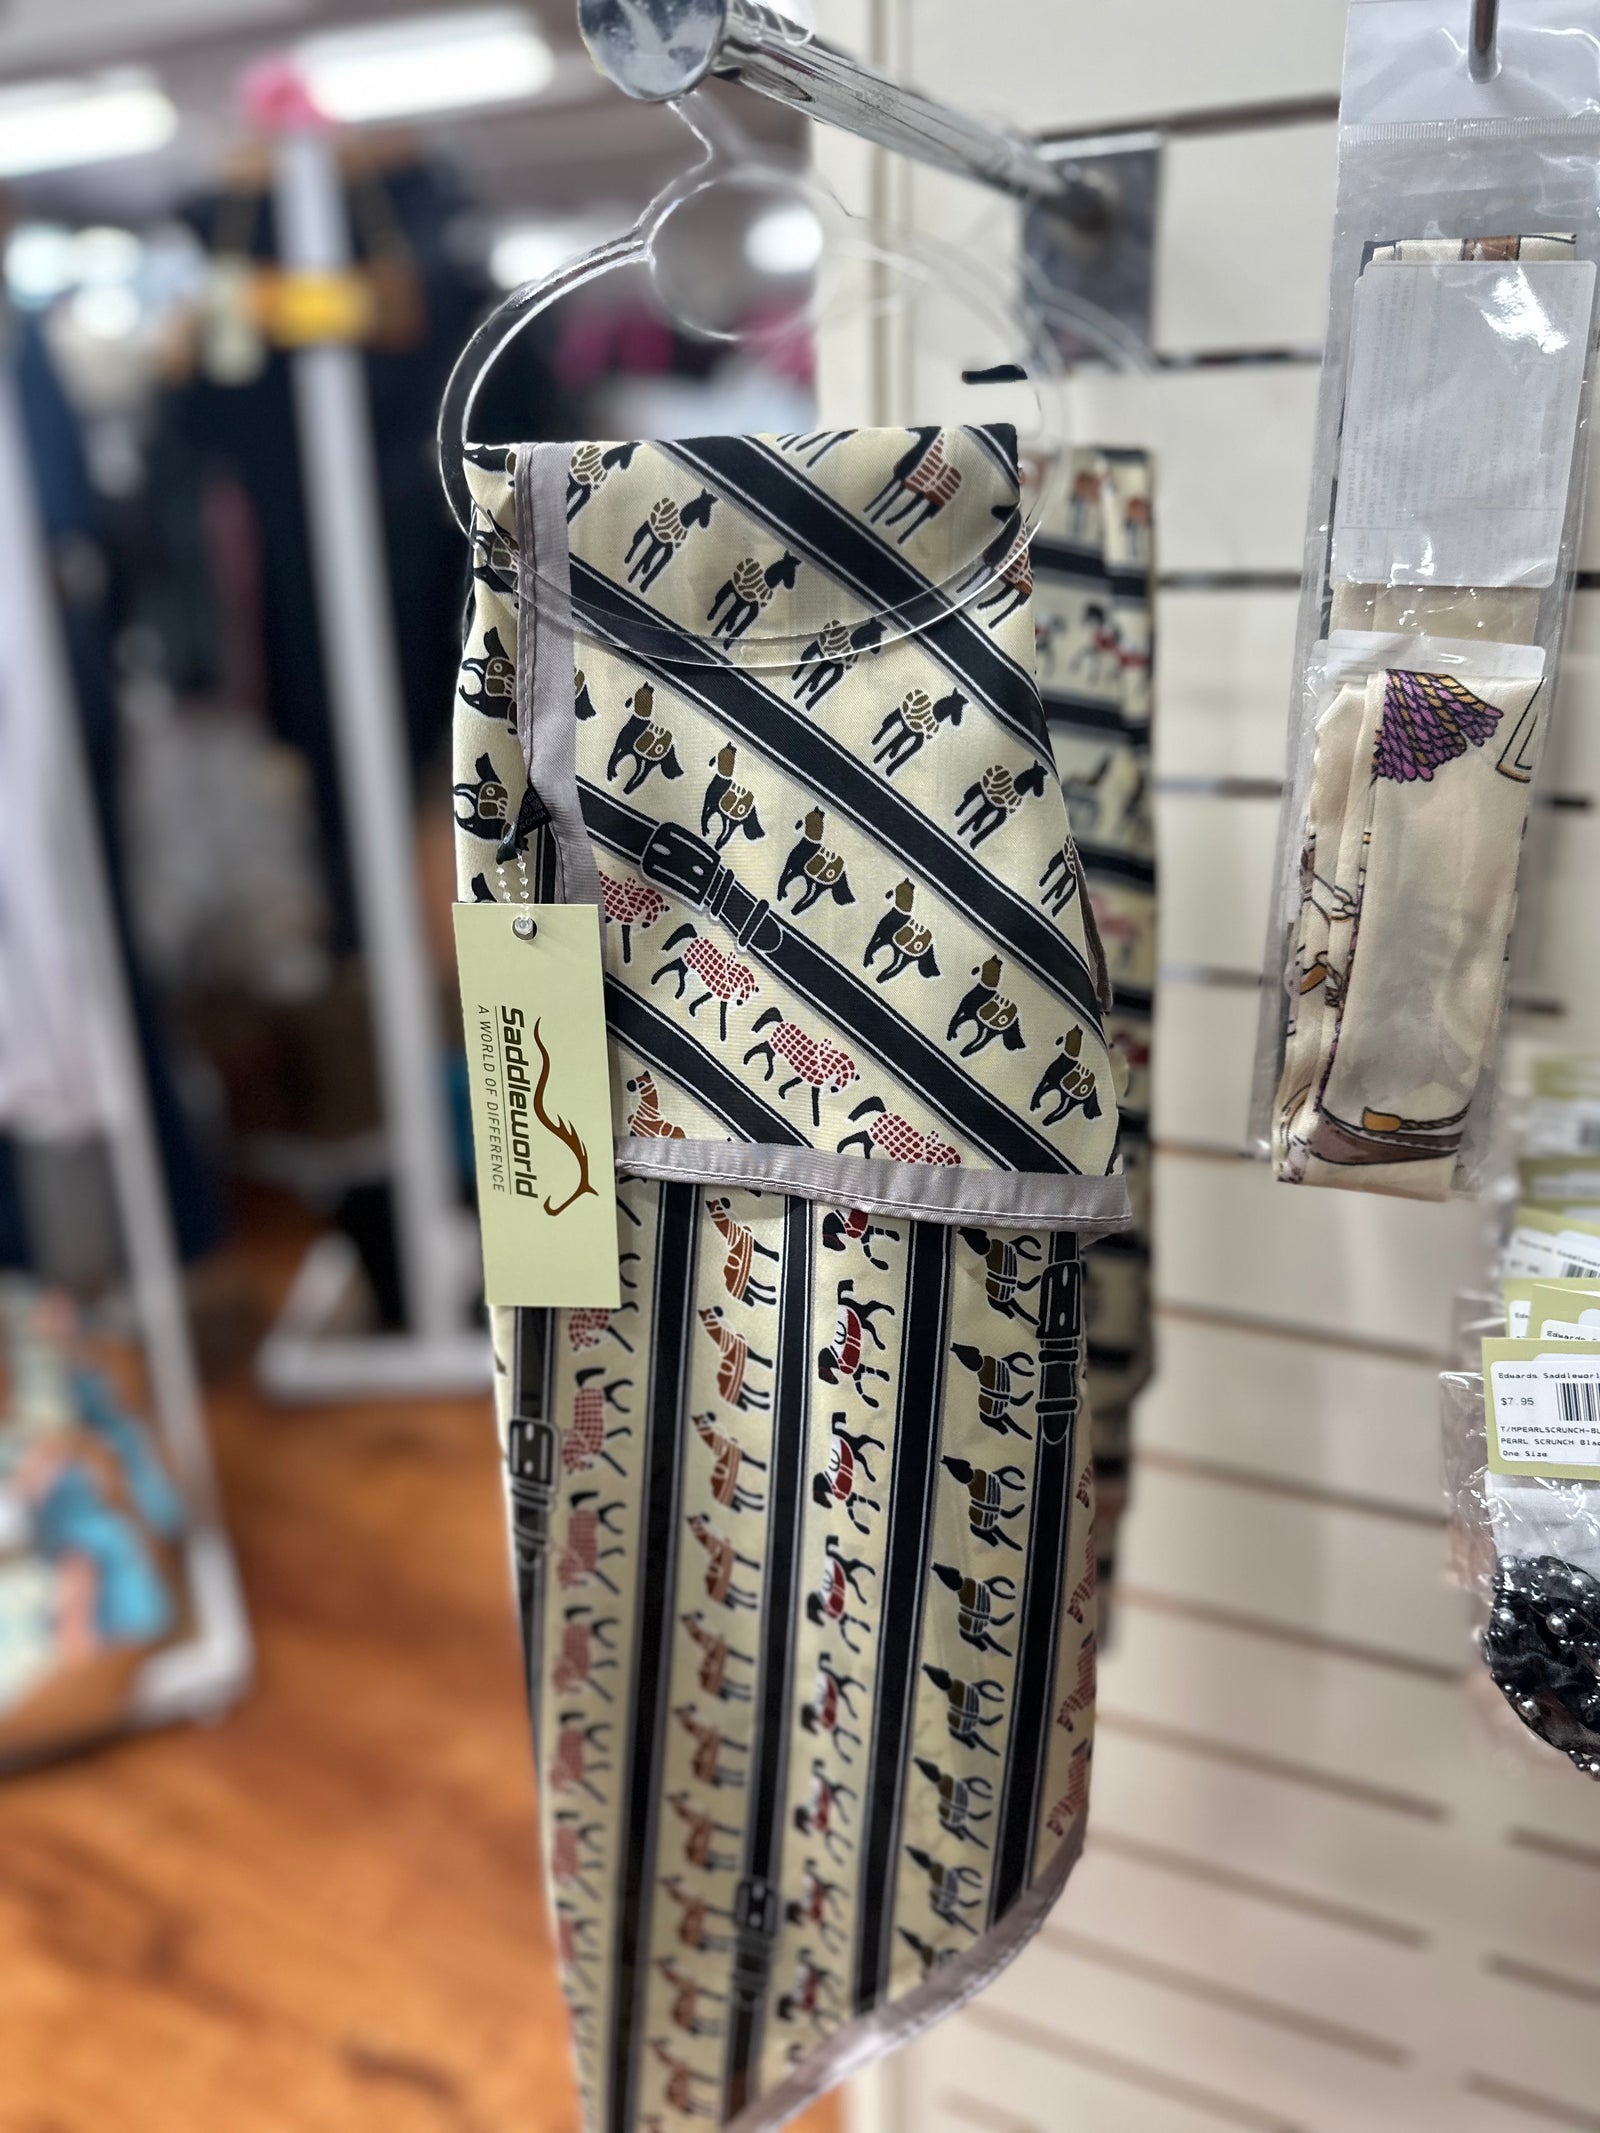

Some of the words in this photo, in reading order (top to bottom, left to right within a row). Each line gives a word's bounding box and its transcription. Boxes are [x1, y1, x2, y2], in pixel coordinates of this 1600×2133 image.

[478, 1004, 490, 1014] A
[480, 1021, 495, 1072] WORLD
[484, 1078, 498, 1097] OF
[501, 1005, 539, 1199] Saddleworld
[486, 1101, 505, 1192] DIFFERENCE
[1500, 1397, 1534, 1406] $7.95
[1501, 1437, 1528, 1445] PEARL
